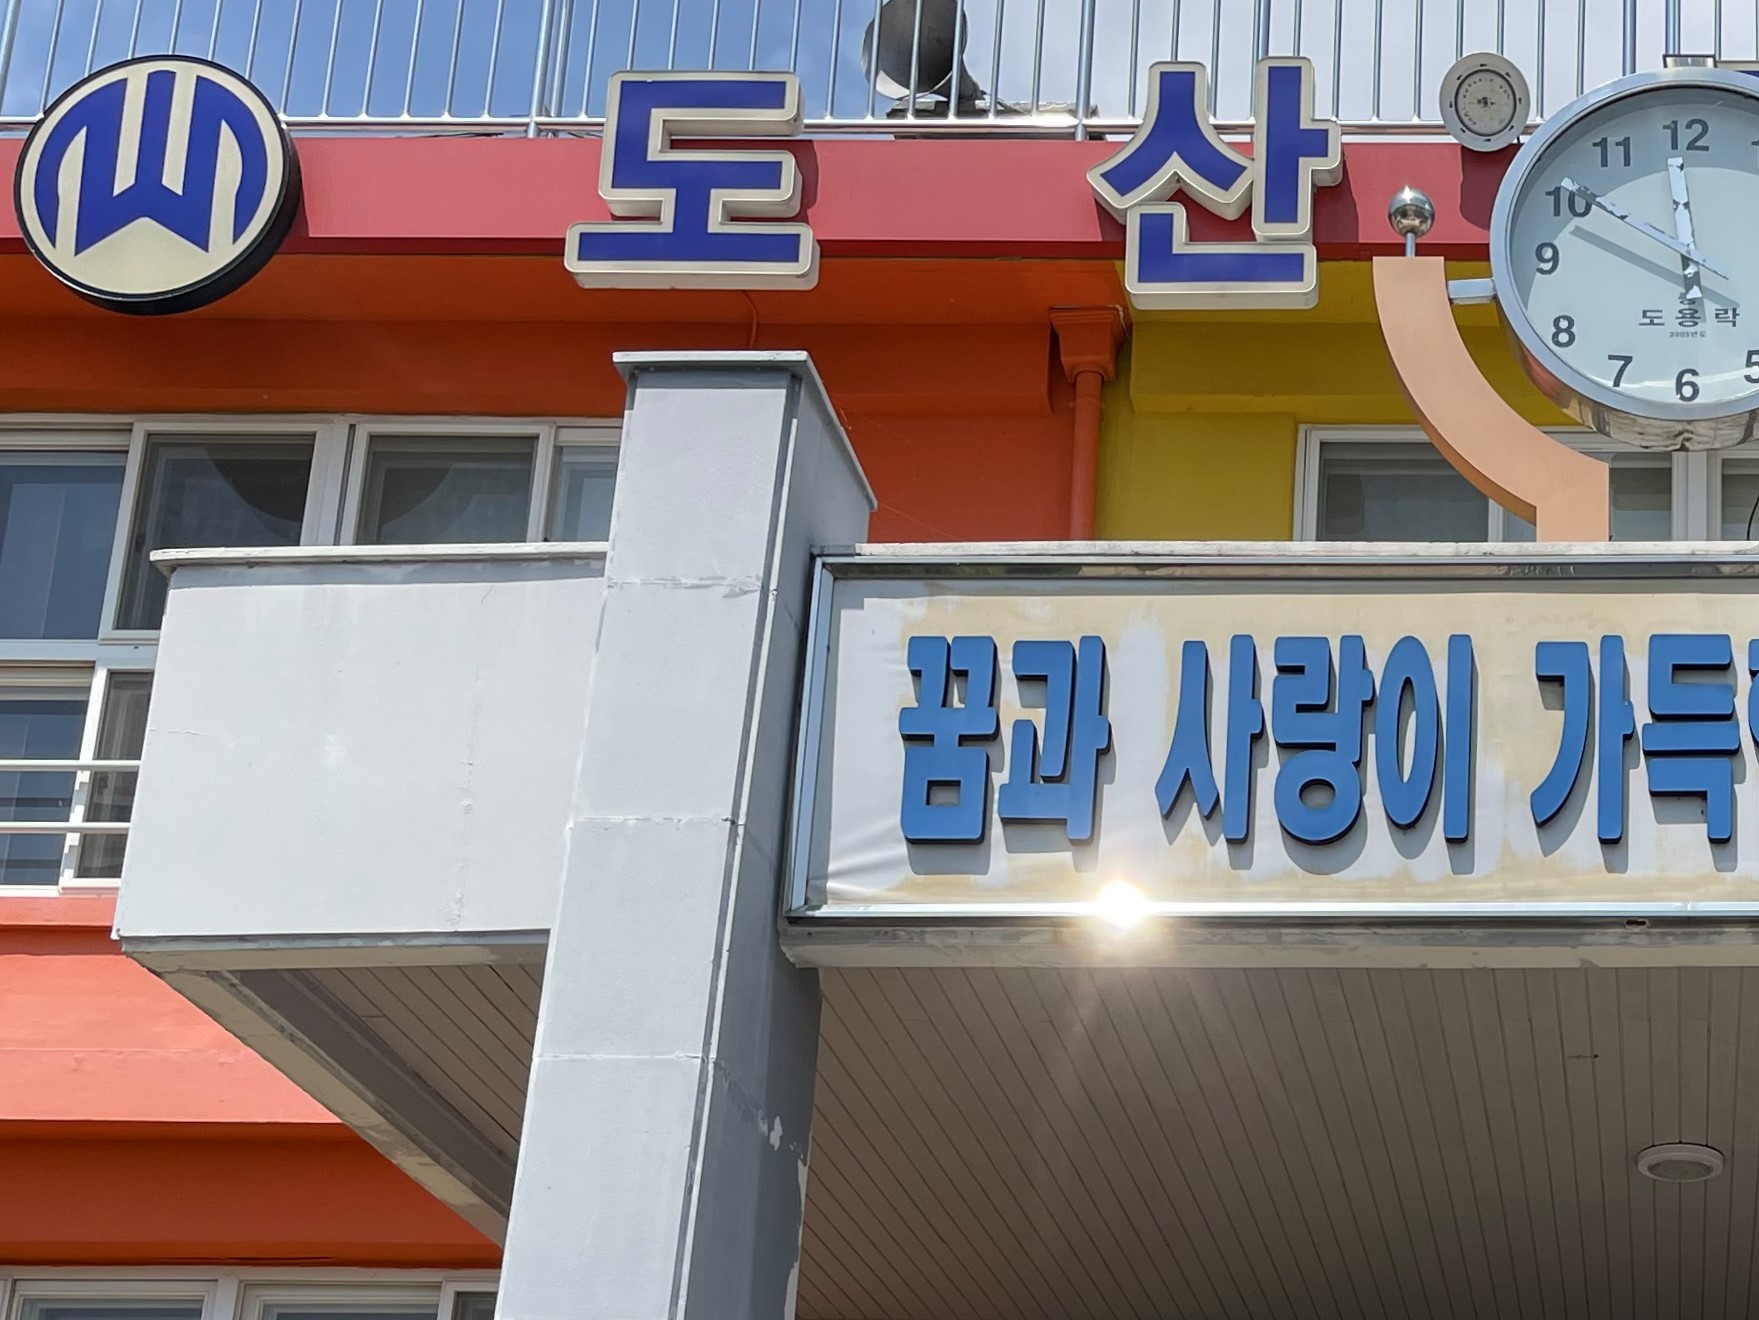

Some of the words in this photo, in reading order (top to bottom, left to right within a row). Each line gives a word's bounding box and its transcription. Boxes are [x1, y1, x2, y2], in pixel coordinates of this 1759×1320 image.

[1592, 136, 1632, 168] 11
[1662, 118, 1710, 152] 12
[1545, 186, 1593, 218] 10
[1534, 242, 1560, 276] 9
[1552, 314, 1576, 348] 8
[1607, 354, 1633, 388] 7
[1675, 368, 1700, 402] 6
[899, 635, 1111, 844] 꿈과
[1155, 633, 1475, 845] 사랑이
